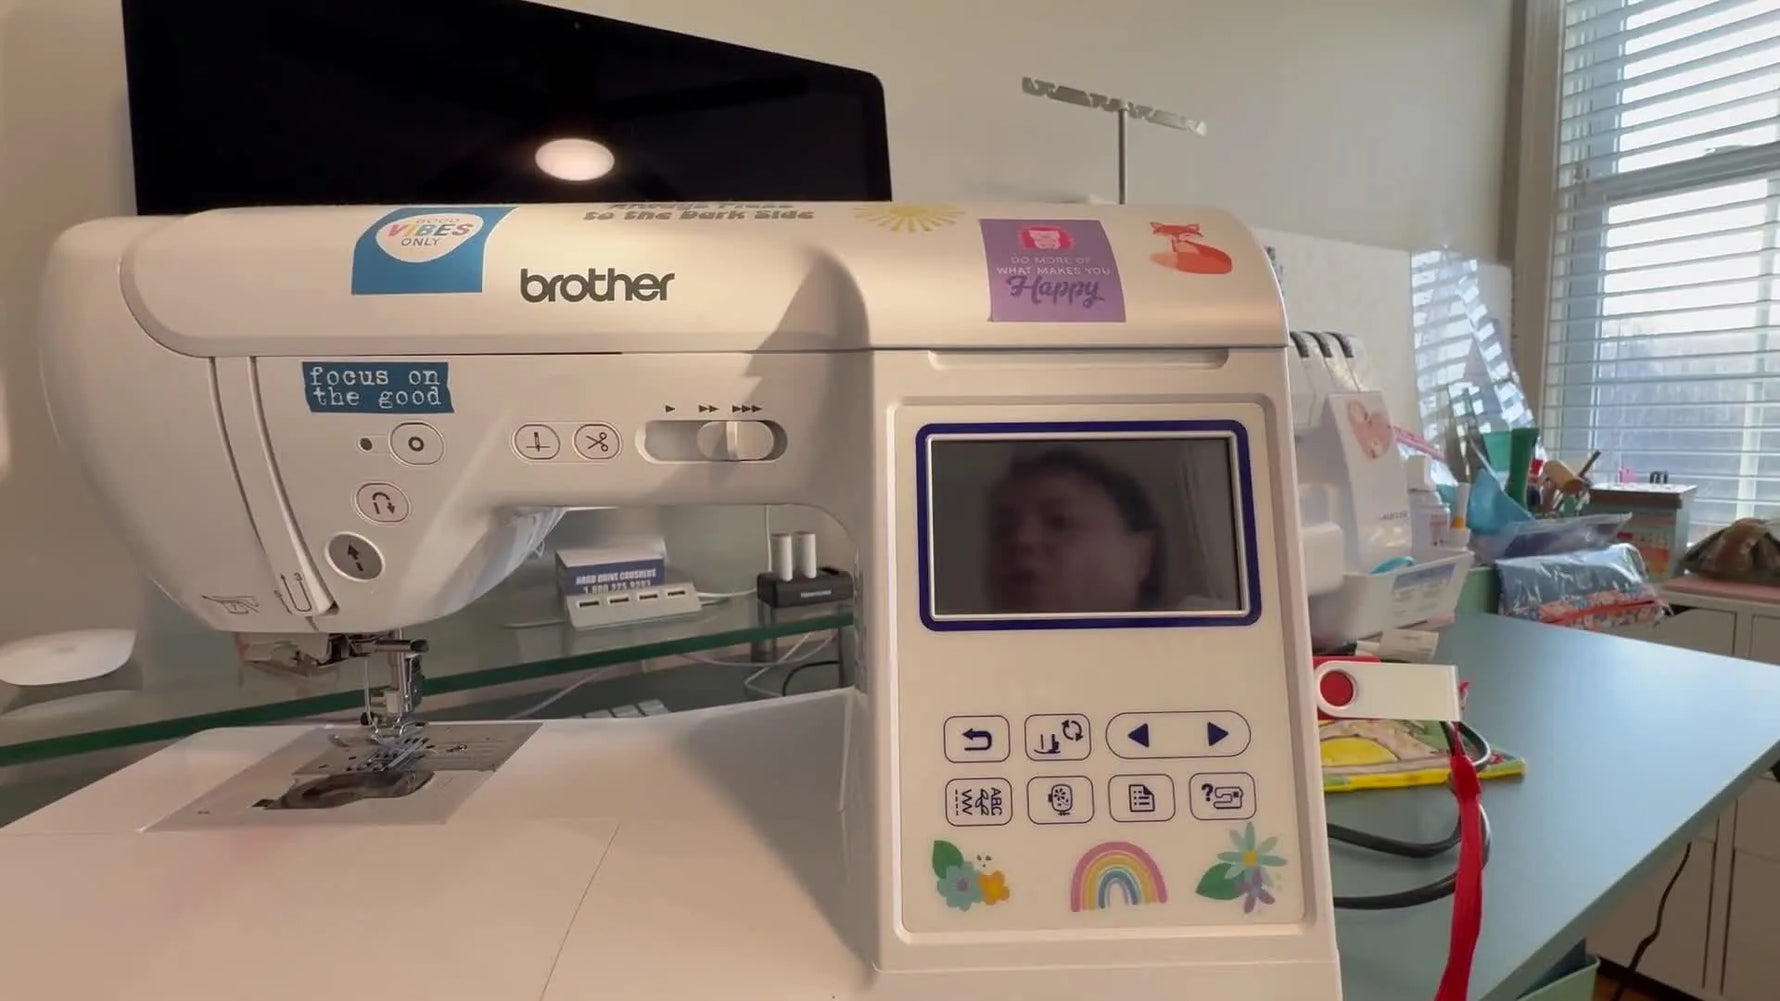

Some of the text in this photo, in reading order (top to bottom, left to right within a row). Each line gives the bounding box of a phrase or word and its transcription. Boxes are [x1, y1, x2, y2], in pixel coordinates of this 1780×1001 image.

[583, 210, 815, 221] to the Dark Side
[388, 223, 473, 237] VIBES
[401, 238, 440, 247] ONLY
[1010, 256, 1091, 264] DO MORE OF
[996, 266, 1110, 275] WHAT MAKES YOU
[520, 268, 675, 302] brother
[1006, 275, 1106, 309] Happy
[310, 366, 441, 386] focus on
[313, 386, 442, 409] the good
[990, 786, 1003, 816] ABC
